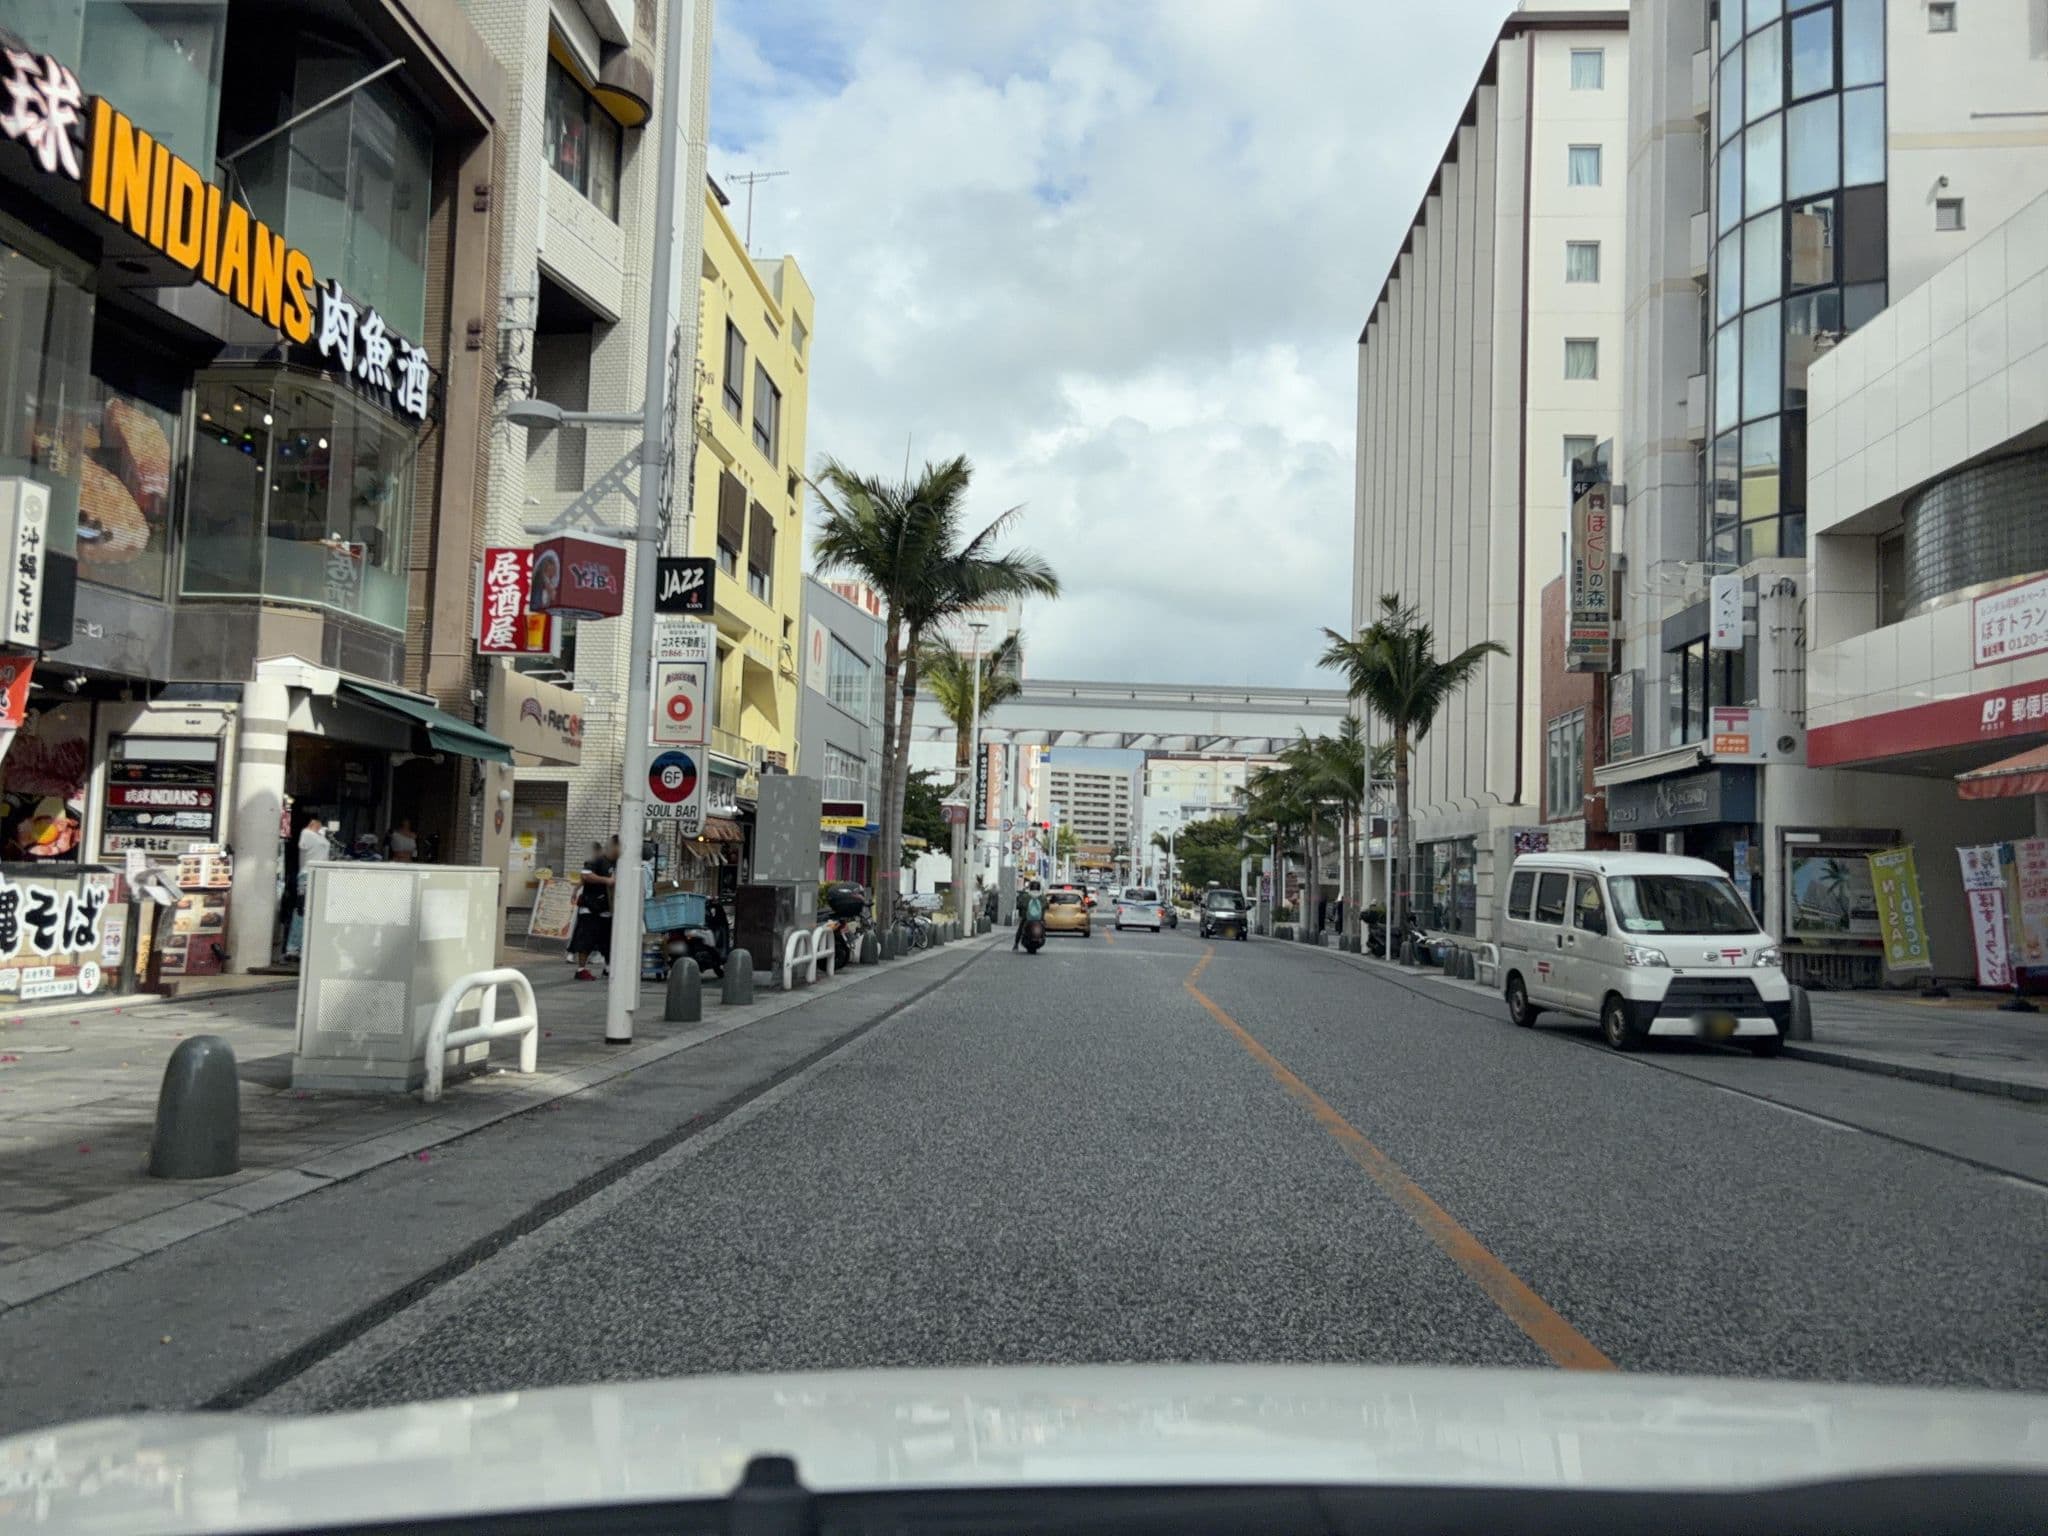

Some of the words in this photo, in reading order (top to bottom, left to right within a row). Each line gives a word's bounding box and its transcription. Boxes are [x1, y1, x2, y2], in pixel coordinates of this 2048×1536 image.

[89, 97, 314, 345] INIDIANS
[317, 279, 430, 420] 肉魚酒
[1574, 483, 1589, 496] 4F
[660, 568, 705, 602] JAZZ
[484, 551, 521, 649] 居酒屋
[664, 771, 681, 784] 6F
[646, 804, 671, 817] SOUL
[675, 804, 697, 818] BAR
